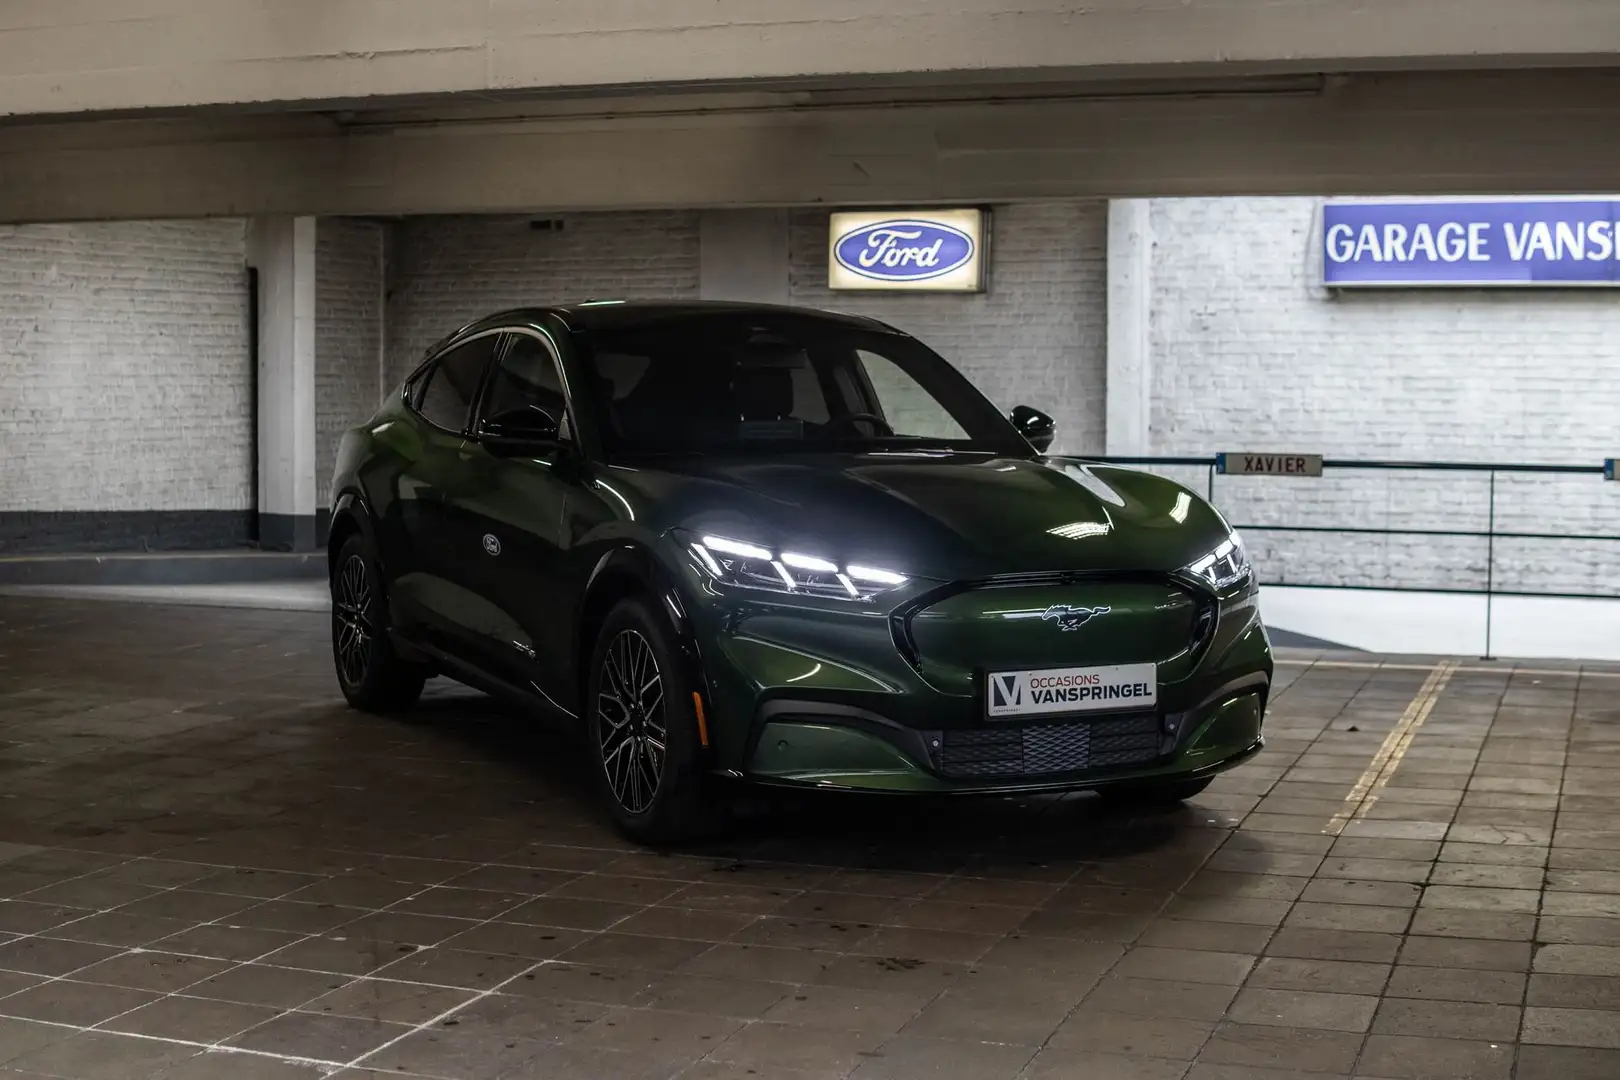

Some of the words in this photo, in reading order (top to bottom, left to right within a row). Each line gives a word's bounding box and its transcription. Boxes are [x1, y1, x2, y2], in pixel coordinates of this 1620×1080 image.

[859, 229, 943, 267] Ford
[1326, 222, 1491, 262] GARAGE
[1244, 456, 1306, 473] XAVIER
[1030, 674, 1100, 689] OCCASIONS
[1031, 683, 1153, 704] VANSPRINGEL
